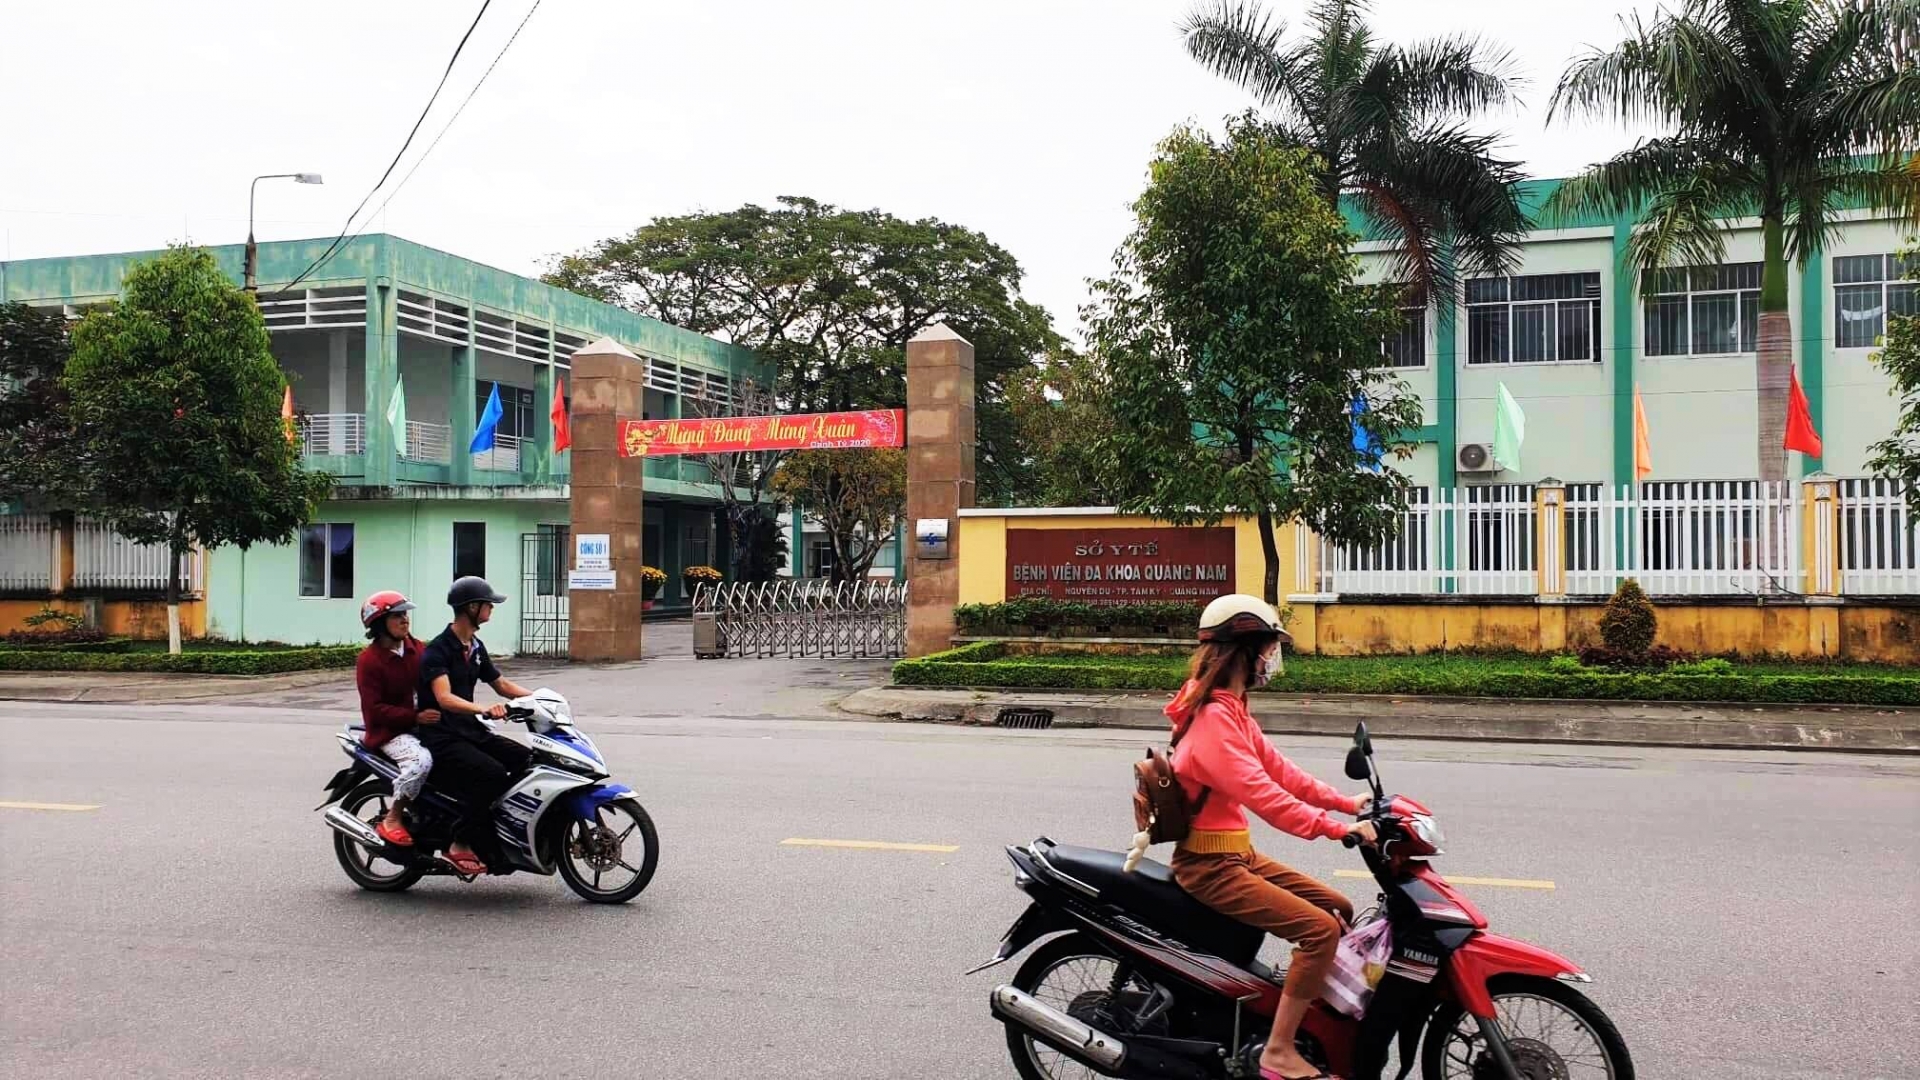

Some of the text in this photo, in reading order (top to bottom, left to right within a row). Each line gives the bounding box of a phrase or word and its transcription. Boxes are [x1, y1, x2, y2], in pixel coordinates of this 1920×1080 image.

[662, 421, 705, 448] Mừng
[763, 416, 807, 444] Mừng
[812, 415, 856, 439] Xuân
[848, 439, 872, 447] 2020
[1075, 538, 1159, 556] SỞ Y TẾ
[1013, 557, 1227, 584] BỆNH VIỆN ĐA KHOA QUẢNG NAM
[1199, 587, 1219, 595] NAM
[1403, 947, 1439, 965] YAMAHA
